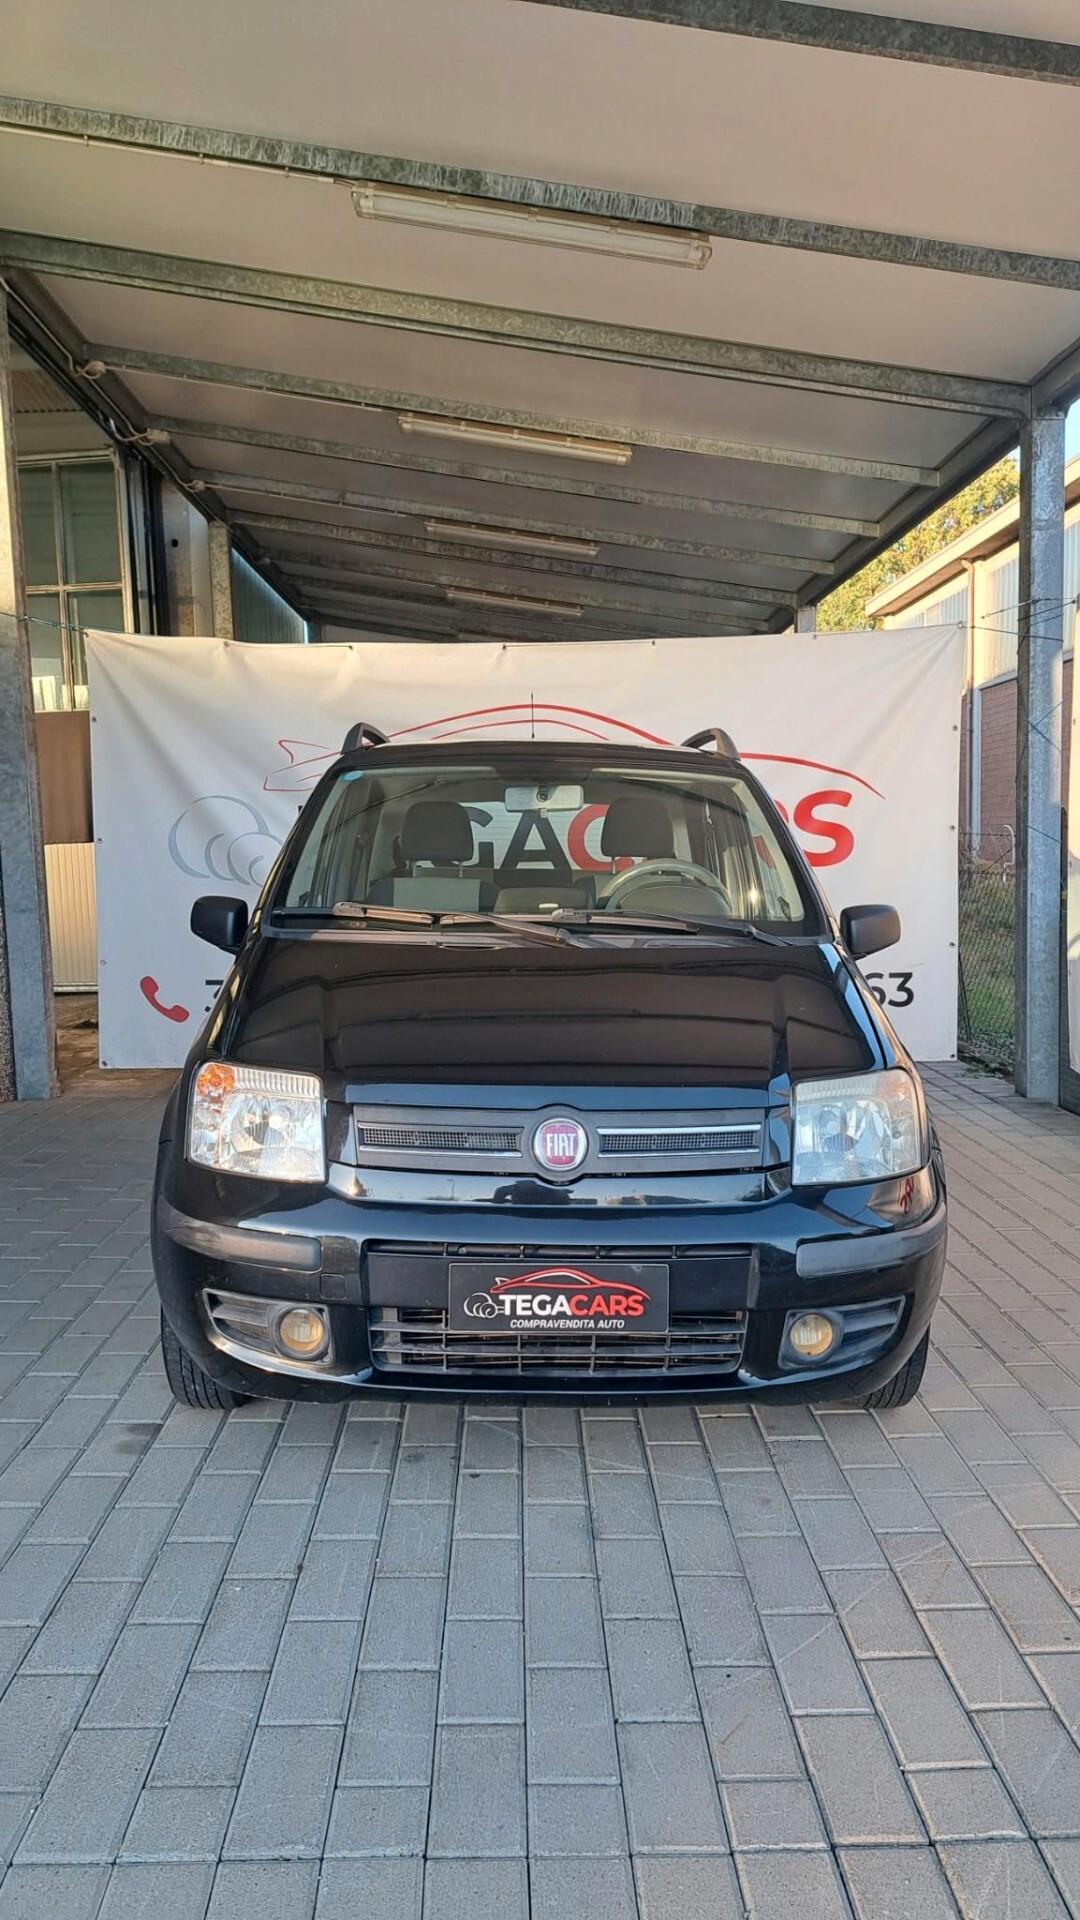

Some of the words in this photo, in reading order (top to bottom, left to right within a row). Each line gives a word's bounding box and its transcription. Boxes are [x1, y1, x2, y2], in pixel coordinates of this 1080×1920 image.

[546, 1133, 577, 1156] FIAT
[499, 1294, 645, 1317] TEGACARS
[510, 1319, 595, 1329] COMPRAVENDITA
[597, 1319, 625, 1329] AUTO
